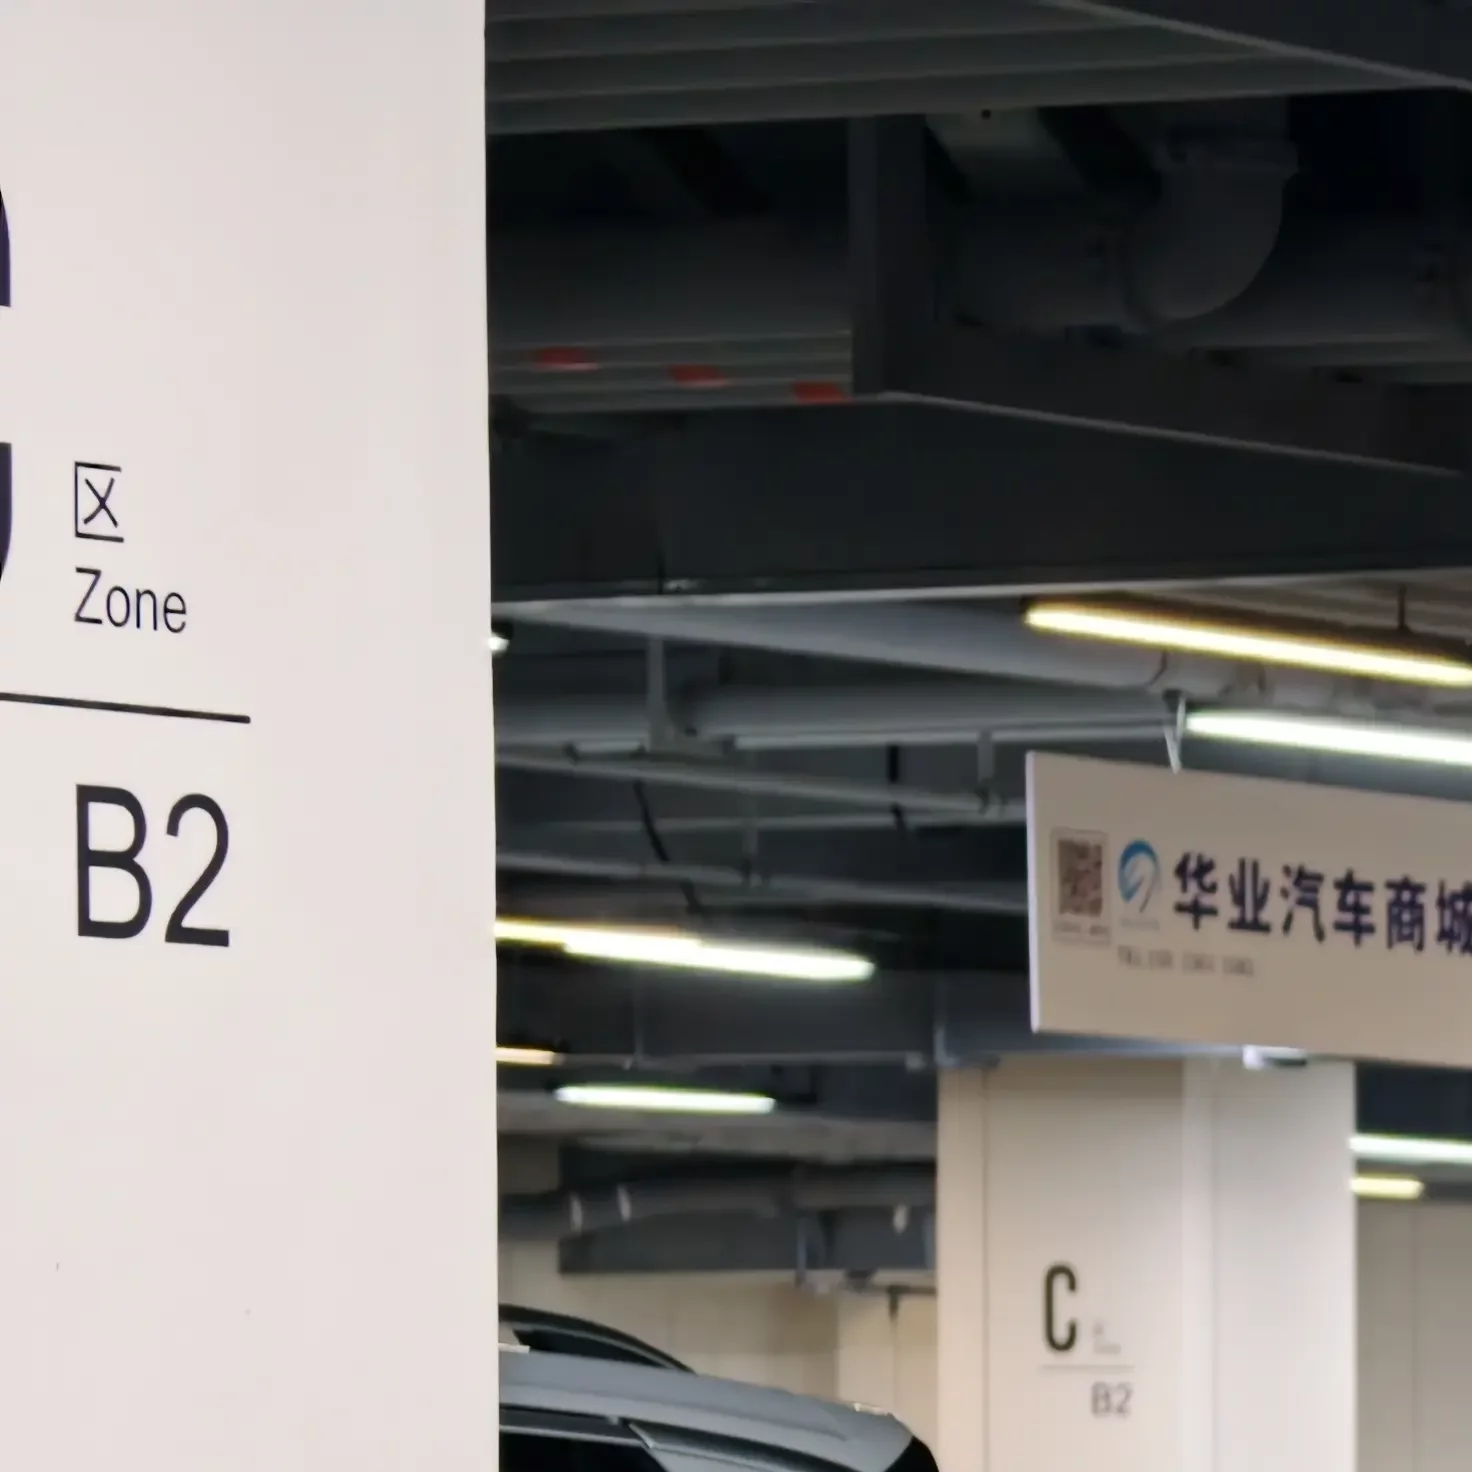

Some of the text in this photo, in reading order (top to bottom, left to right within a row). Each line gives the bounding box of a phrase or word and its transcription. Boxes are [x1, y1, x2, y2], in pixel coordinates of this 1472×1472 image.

[74, 460, 125, 543] 区
[73, 565, 189, 635] Zone
[75, 782, 232, 947] B2
[1045, 1265, 1077, 1351] C
[1089, 1380, 1134, 1418] B2
